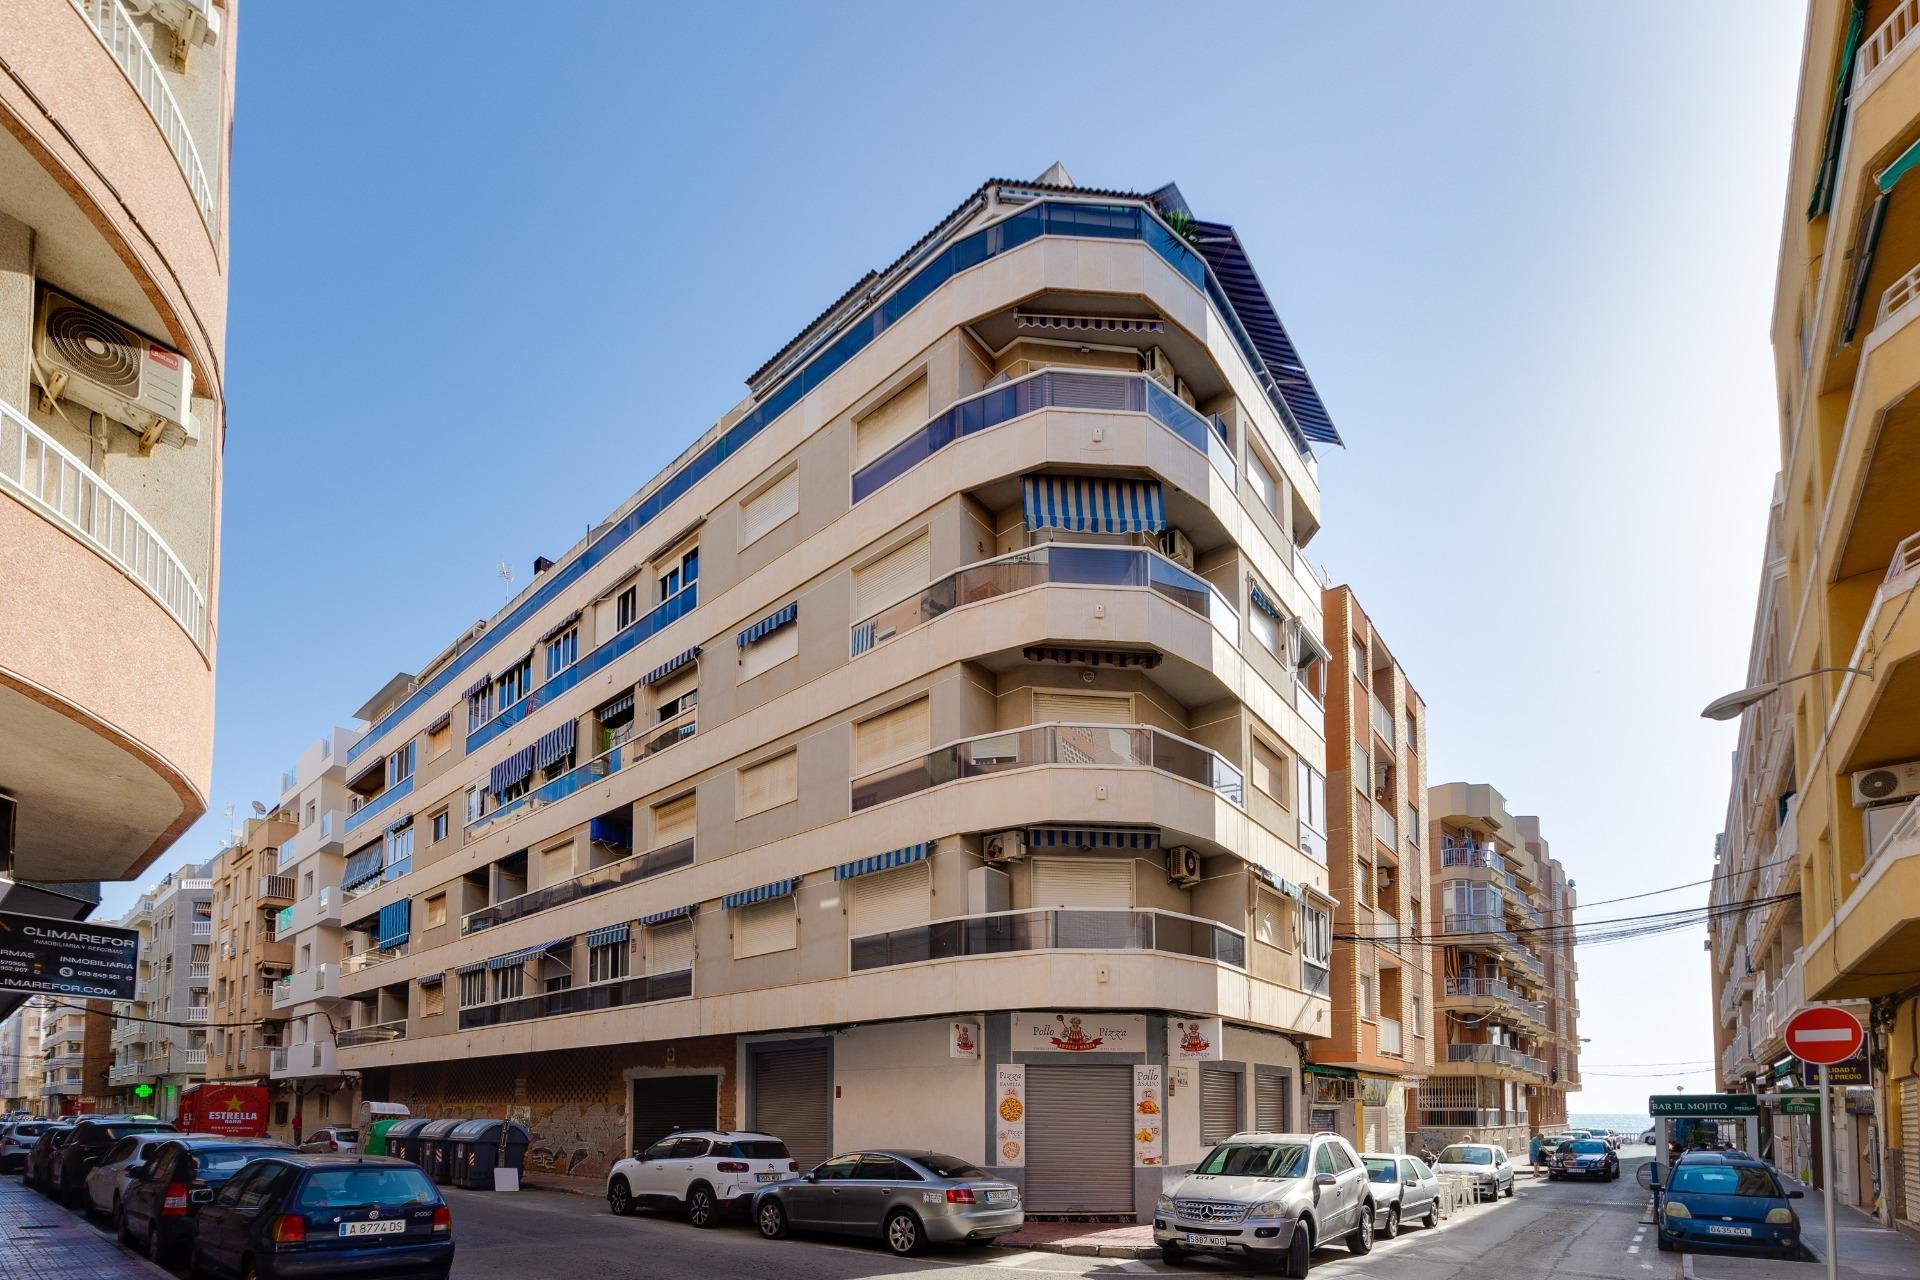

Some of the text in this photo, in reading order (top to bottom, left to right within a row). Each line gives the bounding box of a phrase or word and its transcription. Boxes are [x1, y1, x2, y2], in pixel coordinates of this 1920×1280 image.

[23, 926, 135, 948] CLIMAREFOR
[33, 939, 81, 949] INMOBILIARIA
[88, 946, 123, 954] REFORMAS
[60, 956, 134, 970] INMOBILIARIA
[1033, 1025, 1127, 1041] Pollo Pizza
[999, 1071, 1022, 1081] Pizza
[1137, 1069, 1159, 1081] Pollo
[1144, 1090, 1152, 1098] 12
[1687, 1102, 1727, 1112] MOJITO
[208, 1111, 257, 1120] ESTRELLA
[1150, 1127, 1159, 1135] 15
[349, 1222, 402, 1235] A 8774 DS
